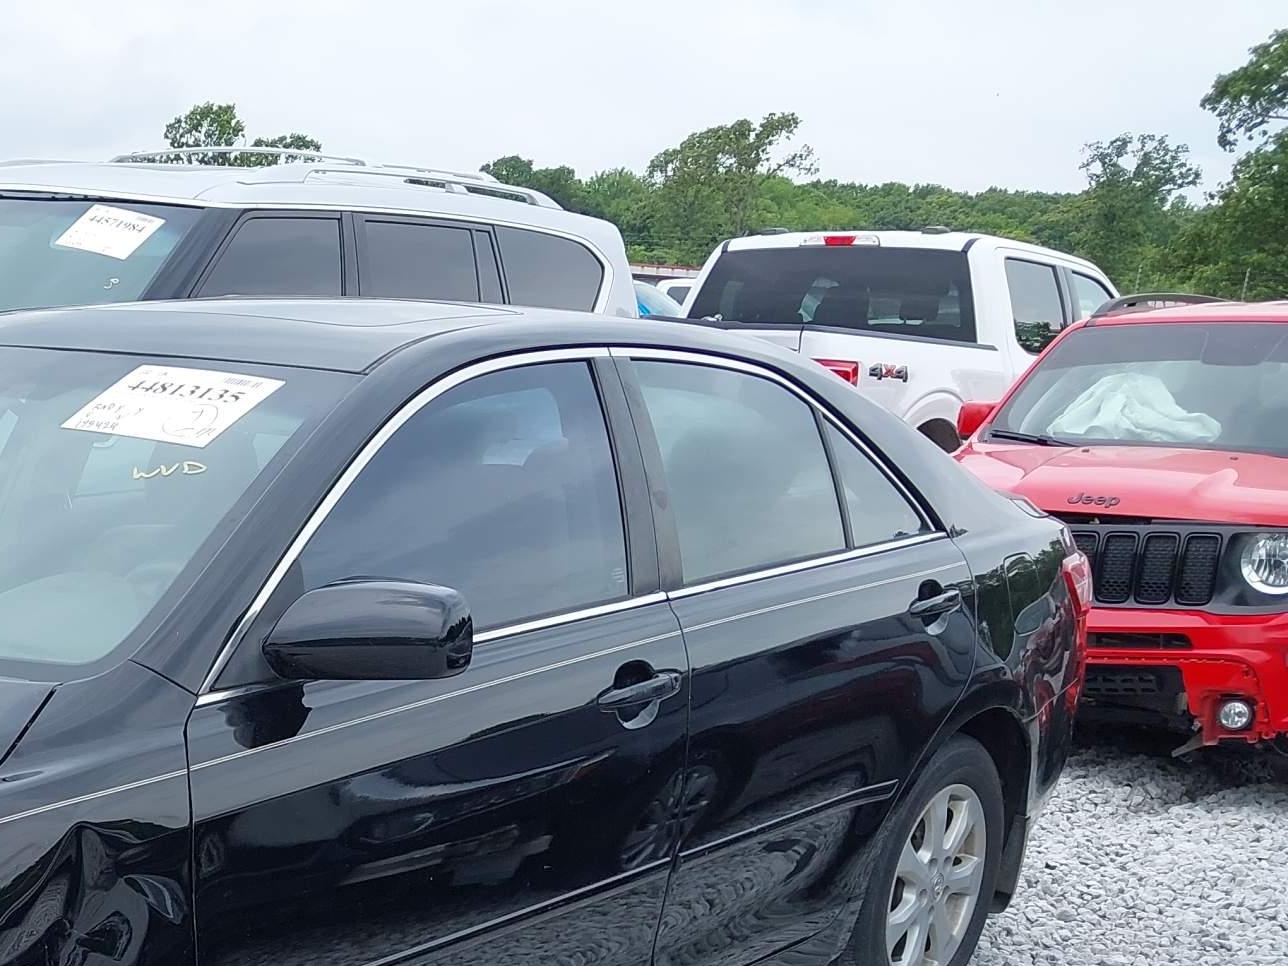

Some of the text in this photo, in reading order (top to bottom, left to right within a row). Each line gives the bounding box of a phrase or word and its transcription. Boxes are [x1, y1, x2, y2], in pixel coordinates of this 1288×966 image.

[88, 214, 146, 233] 44571984
[127, 379, 247, 403] 44813135
[1067, 492, 1121, 509] Jeep
